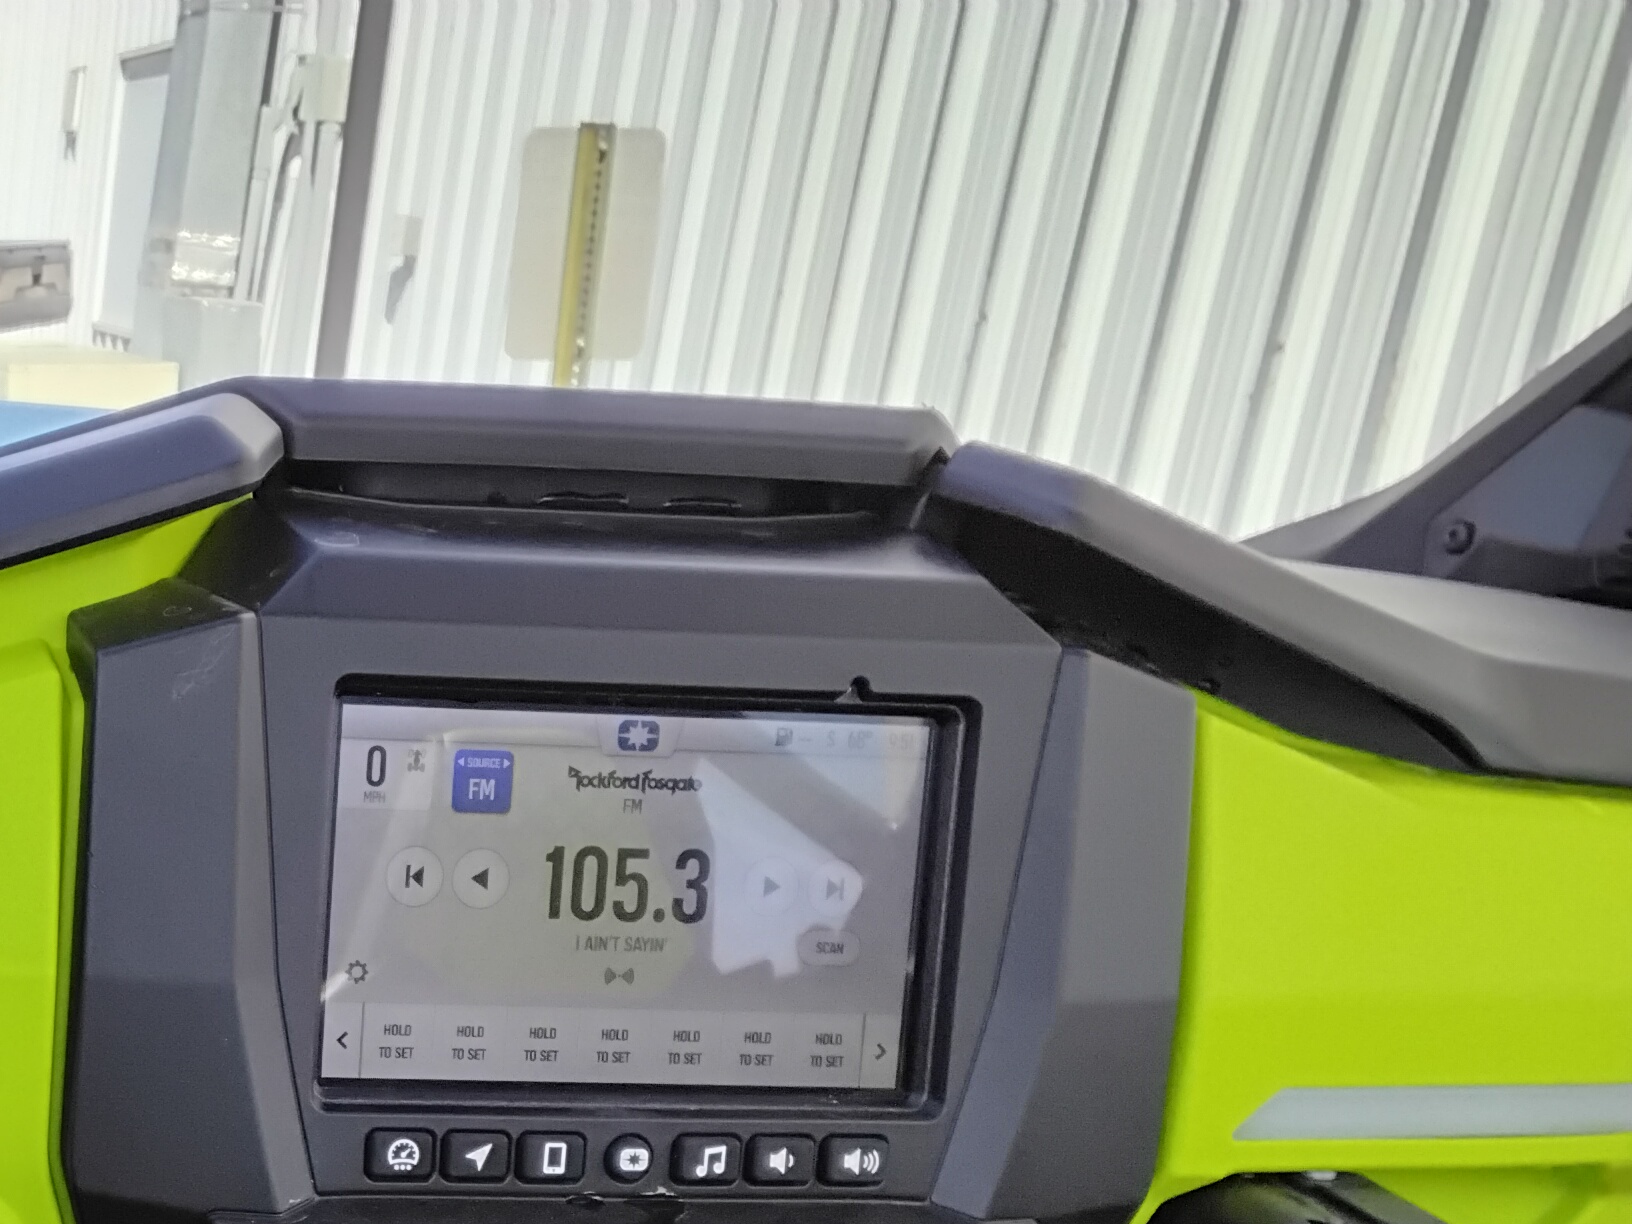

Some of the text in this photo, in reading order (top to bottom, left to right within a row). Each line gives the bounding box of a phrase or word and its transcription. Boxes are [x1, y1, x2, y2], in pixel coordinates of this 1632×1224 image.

[366, 745, 387, 787] 0
[468, 757, 501, 768] SOURCE
[469, 778, 496, 801] FM
[363, 790, 386, 803] MPH
[623, 799, 643, 814] FM
[546, 845, 711, 925] 105.3
[584, 935, 619, 951] AIN'T
[815, 941, 844, 955] SCAN
[383, 1024, 412, 1037] HOLD
[457, 1025, 485, 1038] HOLD
[529, 1027, 557, 1040] HOLD
[601, 1029, 629, 1041] HOLD
[673, 1030, 700, 1043] HOLD
[744, 1031, 771, 1045] HOLD
[815, 1033, 843, 1046] HOLD
[379, 1046, 414, 1059] TO SET
[452, 1048, 486, 1060] TO SET
[524, 1050, 559, 1062] TO SET
[596, 1051, 631, 1064] TO SET
[668, 1052, 702, 1065] TO SET
[739, 1054, 774, 1067] TO SET
[810, 1055, 844, 1068] TO SET
